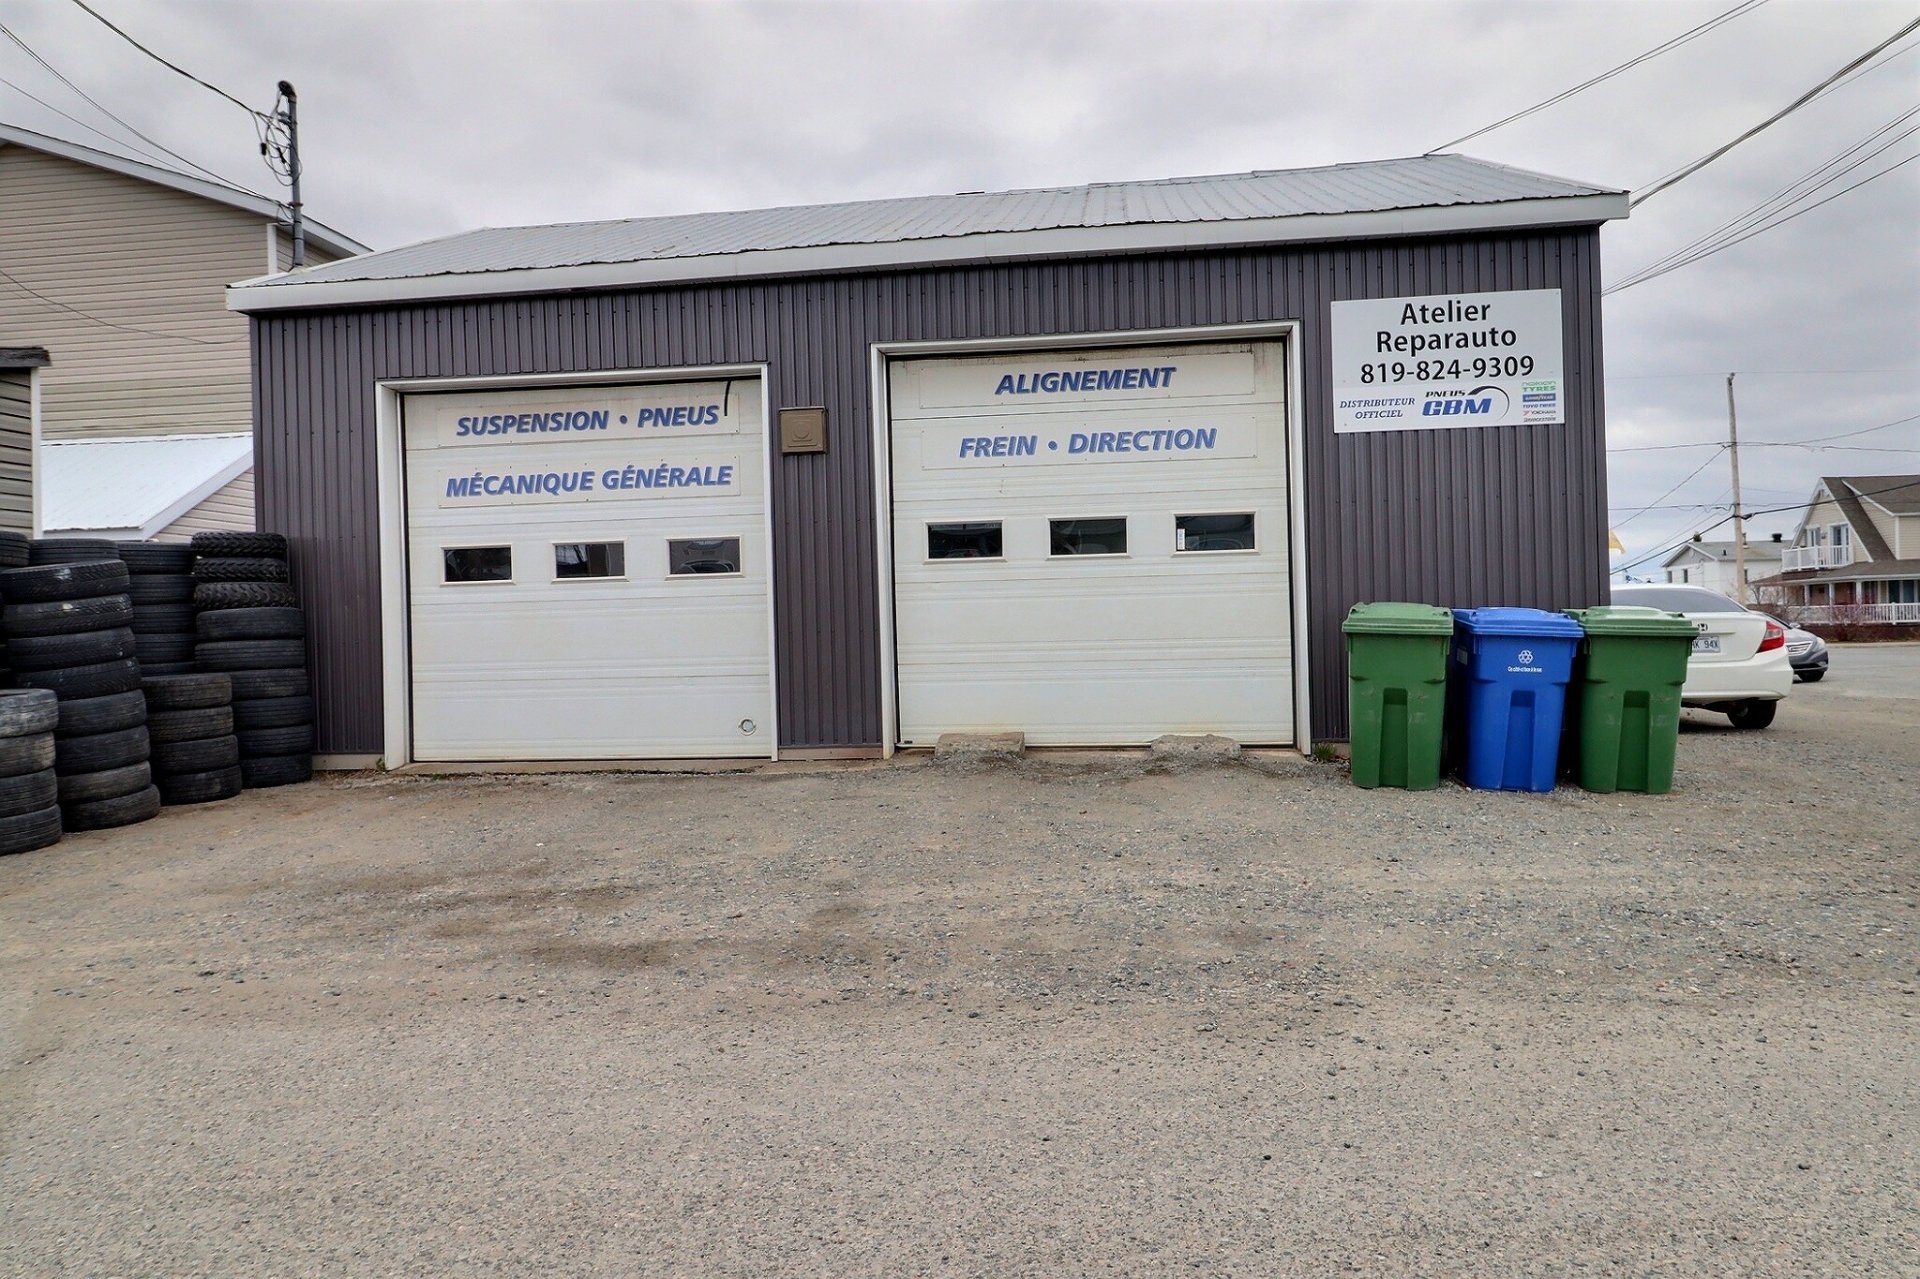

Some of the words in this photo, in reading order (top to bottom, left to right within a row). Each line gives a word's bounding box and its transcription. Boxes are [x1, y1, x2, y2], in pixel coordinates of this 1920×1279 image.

[1400, 300, 1491, 326] Atelier
[1376, 327, 1517, 357] Reparauto
[995, 366, 1177, 395] ALIGNEMENT
[1360, 355, 1535, 384] 819-824-9309
[1340, 398, 1416, 409] DISTRIBUTEUR
[1422, 398, 1492, 417] GBM
[1425, 390, 1466, 398] PNEUS
[456, 410, 609, 437] SUSPENSION
[637, 404, 719, 428] PNEUS
[1355, 409, 1403, 420] OFFICIEL
[959, 435, 1038, 458] FREIN
[1068, 428, 1218, 454] DIRECTION
[446, 471, 595, 497] MÉCANIQUE
[602, 463, 733, 490] GÉNÉRALE
